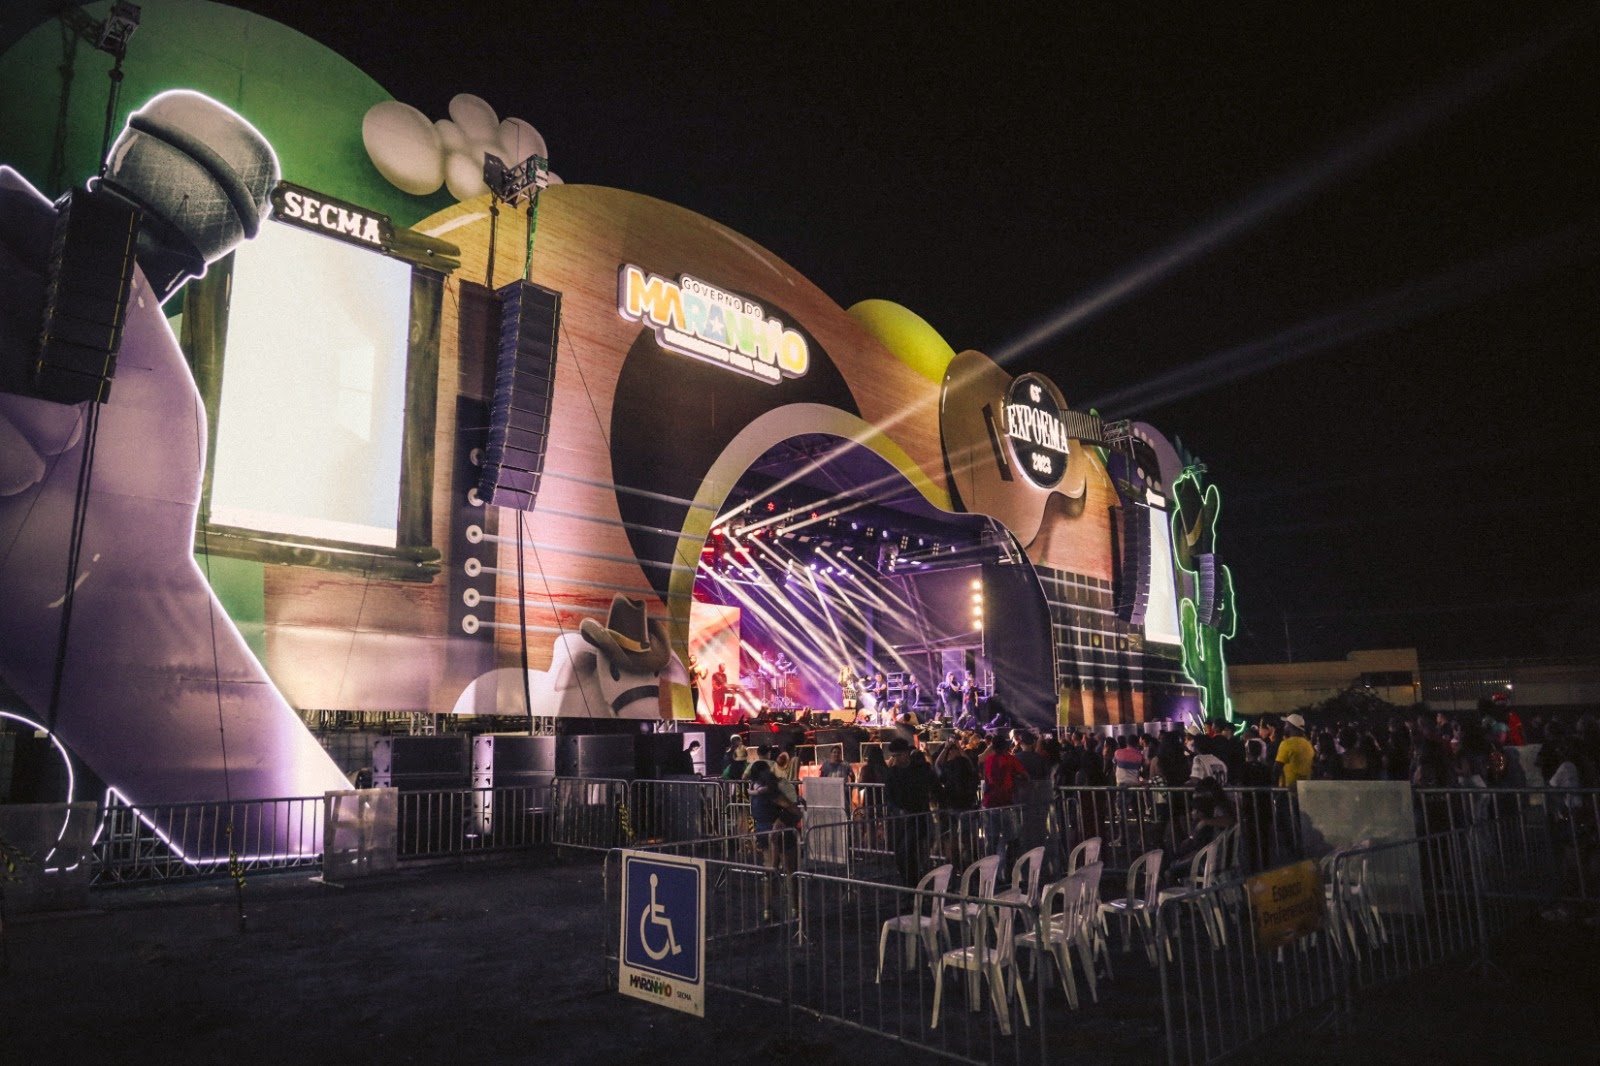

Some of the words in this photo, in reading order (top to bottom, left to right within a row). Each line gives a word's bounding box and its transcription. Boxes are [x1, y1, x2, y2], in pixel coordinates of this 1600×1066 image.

[285, 191, 381, 244] SECMA
[683, 279, 741, 310] GOVERNO
[746, 304, 761, 318] DO
[1007, 404, 1070, 454] EXPOEMA
